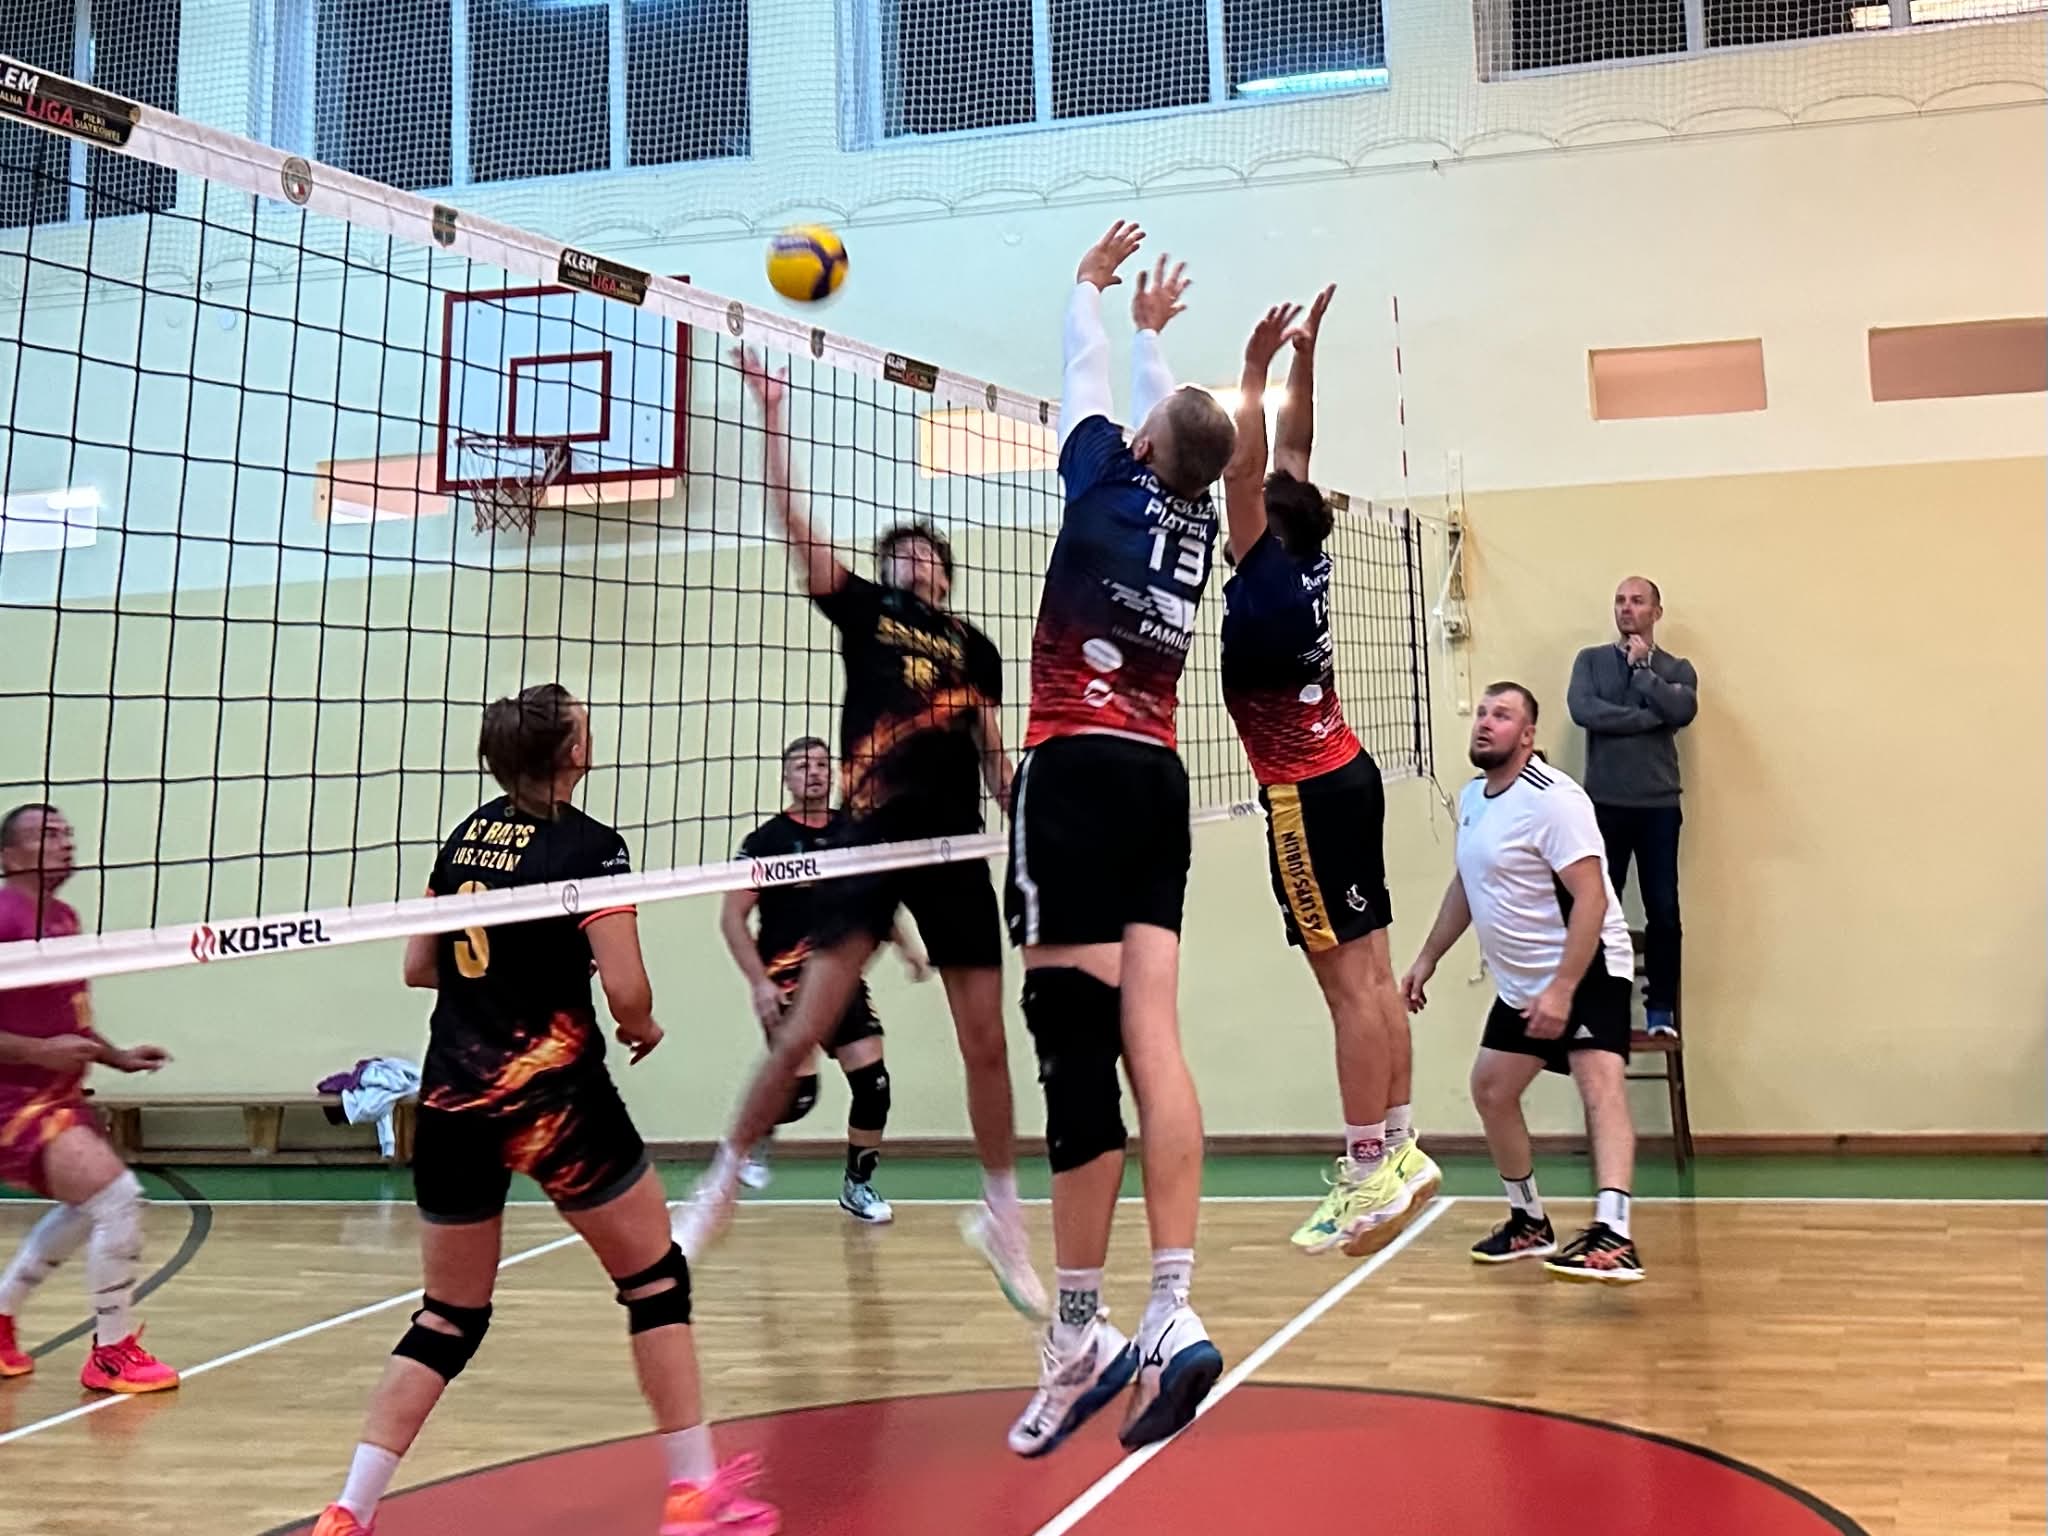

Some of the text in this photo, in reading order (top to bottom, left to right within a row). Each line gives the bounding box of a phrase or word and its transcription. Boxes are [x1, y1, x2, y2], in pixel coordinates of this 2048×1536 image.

[25, 95, 74, 127] LIGA
[563, 250, 598, 274] KLEM
[591, 272, 617, 292] LIGA
[1149, 527, 1206, 587] 13
[765, 857, 822, 882] KOSPEL
[219, 918, 331, 955] KOSPEL
